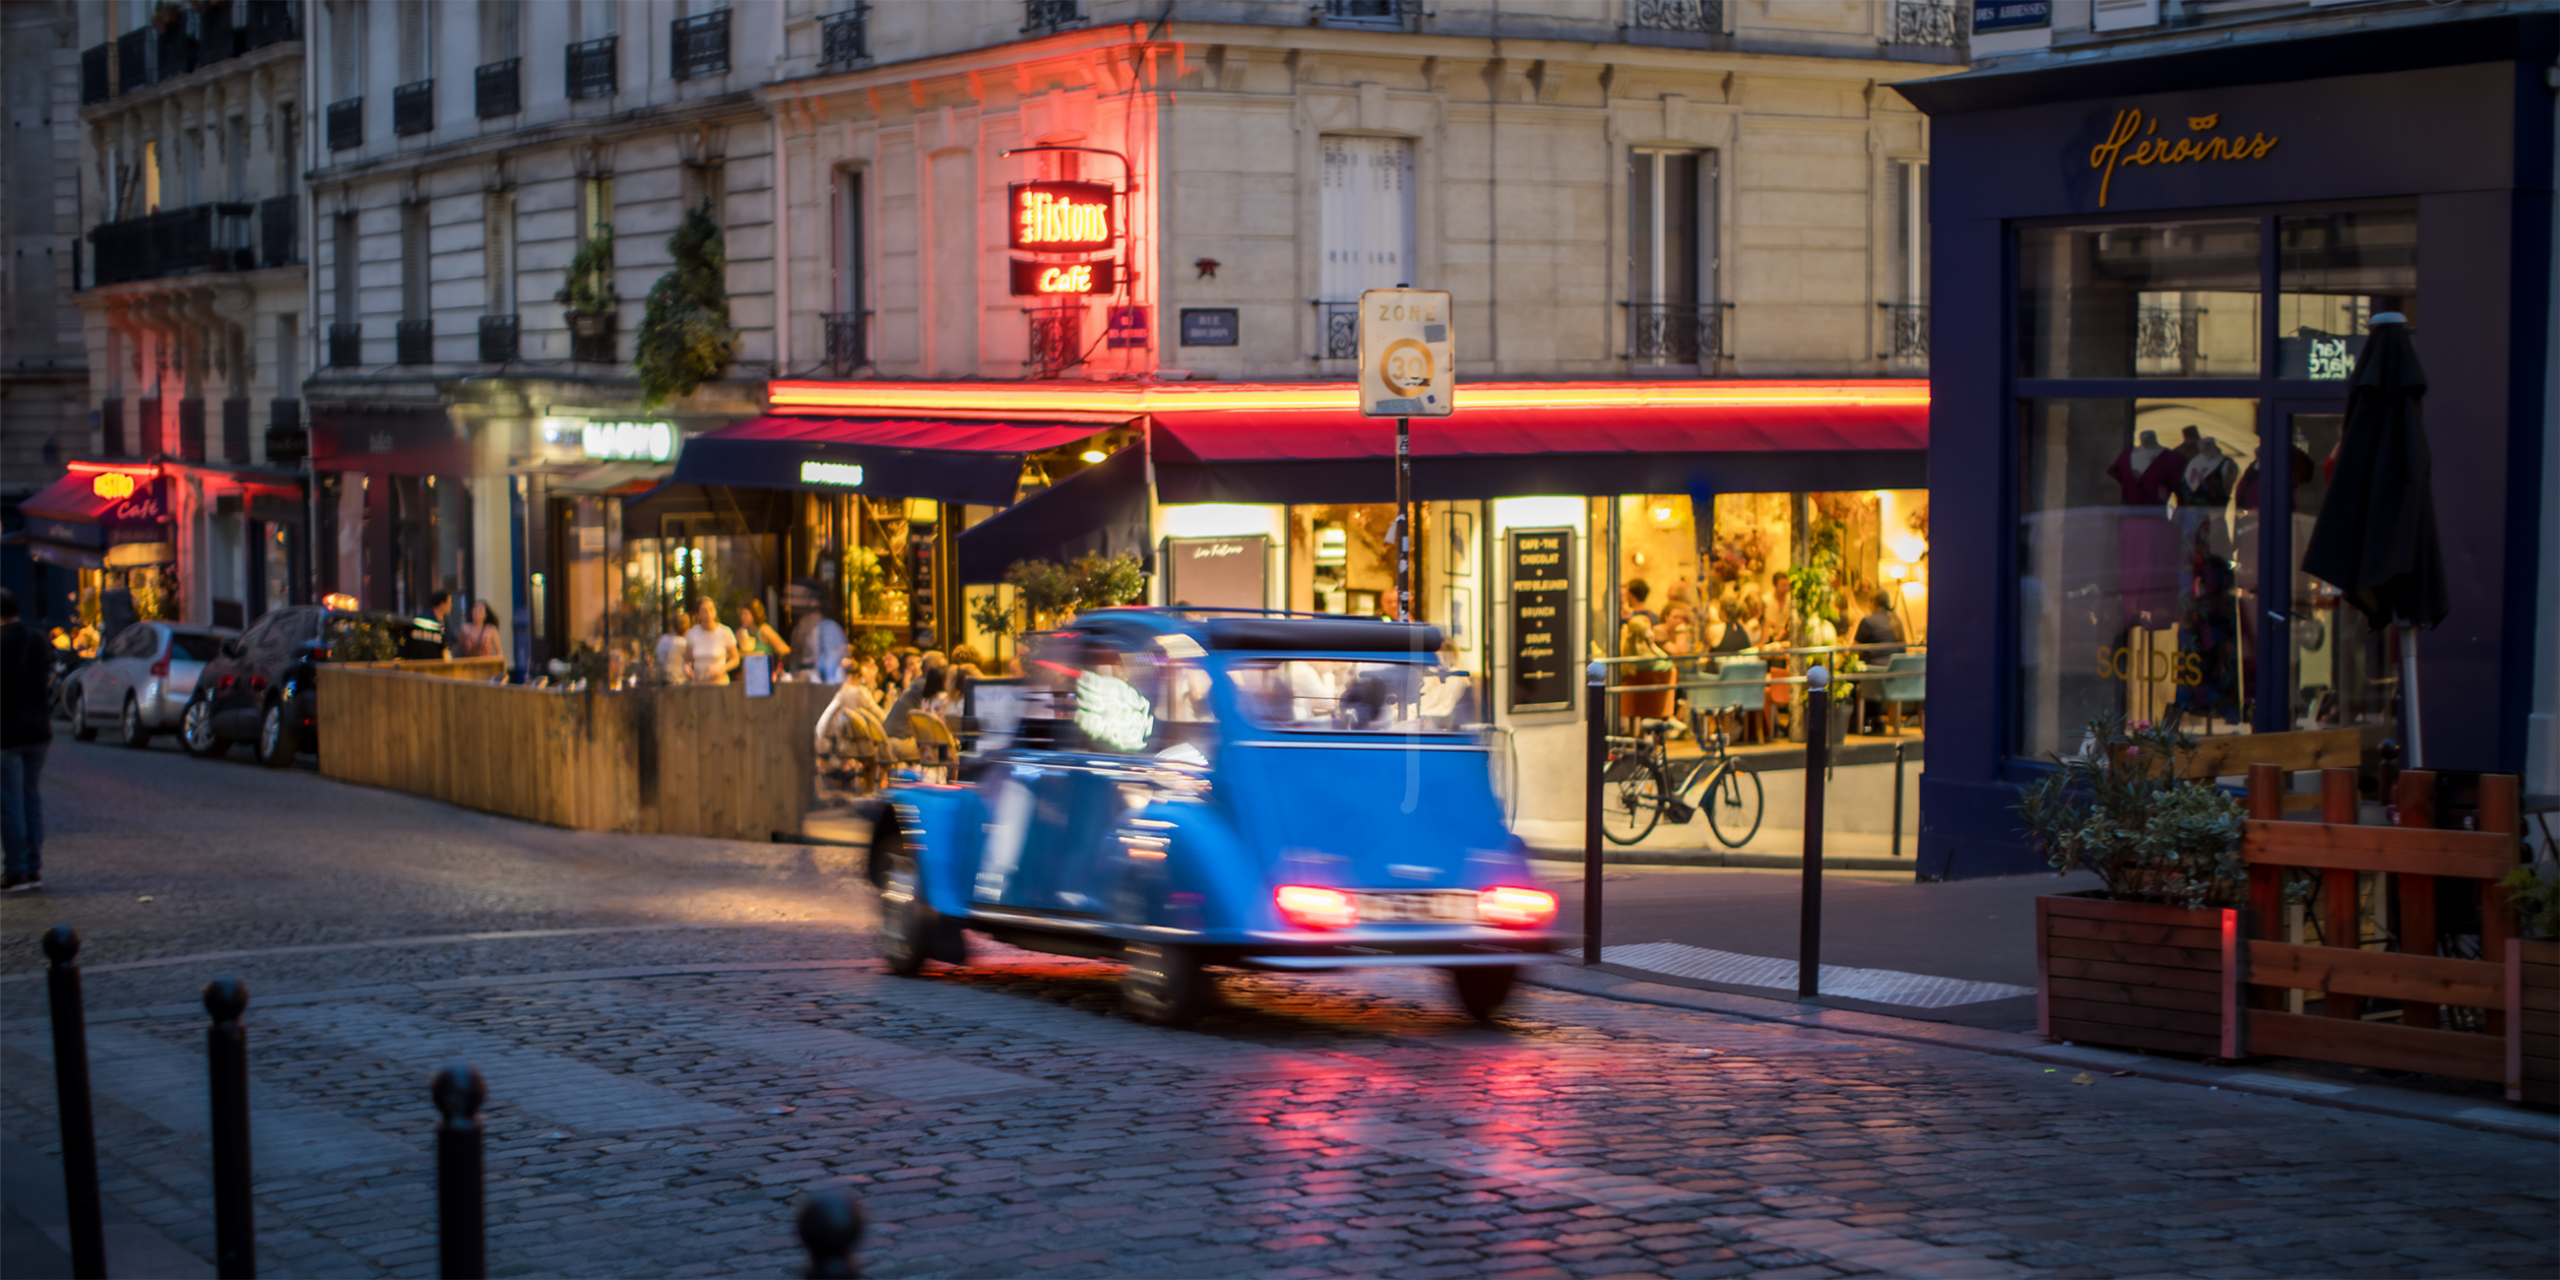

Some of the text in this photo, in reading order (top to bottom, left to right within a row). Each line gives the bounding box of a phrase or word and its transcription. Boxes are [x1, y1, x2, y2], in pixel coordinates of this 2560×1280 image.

[1976, 2, 2048, 21] DES ABBESSES
[1033, 192, 1108, 242] Fistons
[1039, 265, 1092, 292] Café
[1198, 315, 1222, 326] RUE
[1378, 304, 1436, 322] ZONE
[1391, 356, 1424, 380] 30
[117, 498, 159, 519] Café
[1520, 553, 1559, 565] CHOCOLAT
[1521, 606, 1556, 618] BRUNCH
[1525, 632, 1552, 644] SOUPE
[2096, 645, 2203, 686] SOLDES
